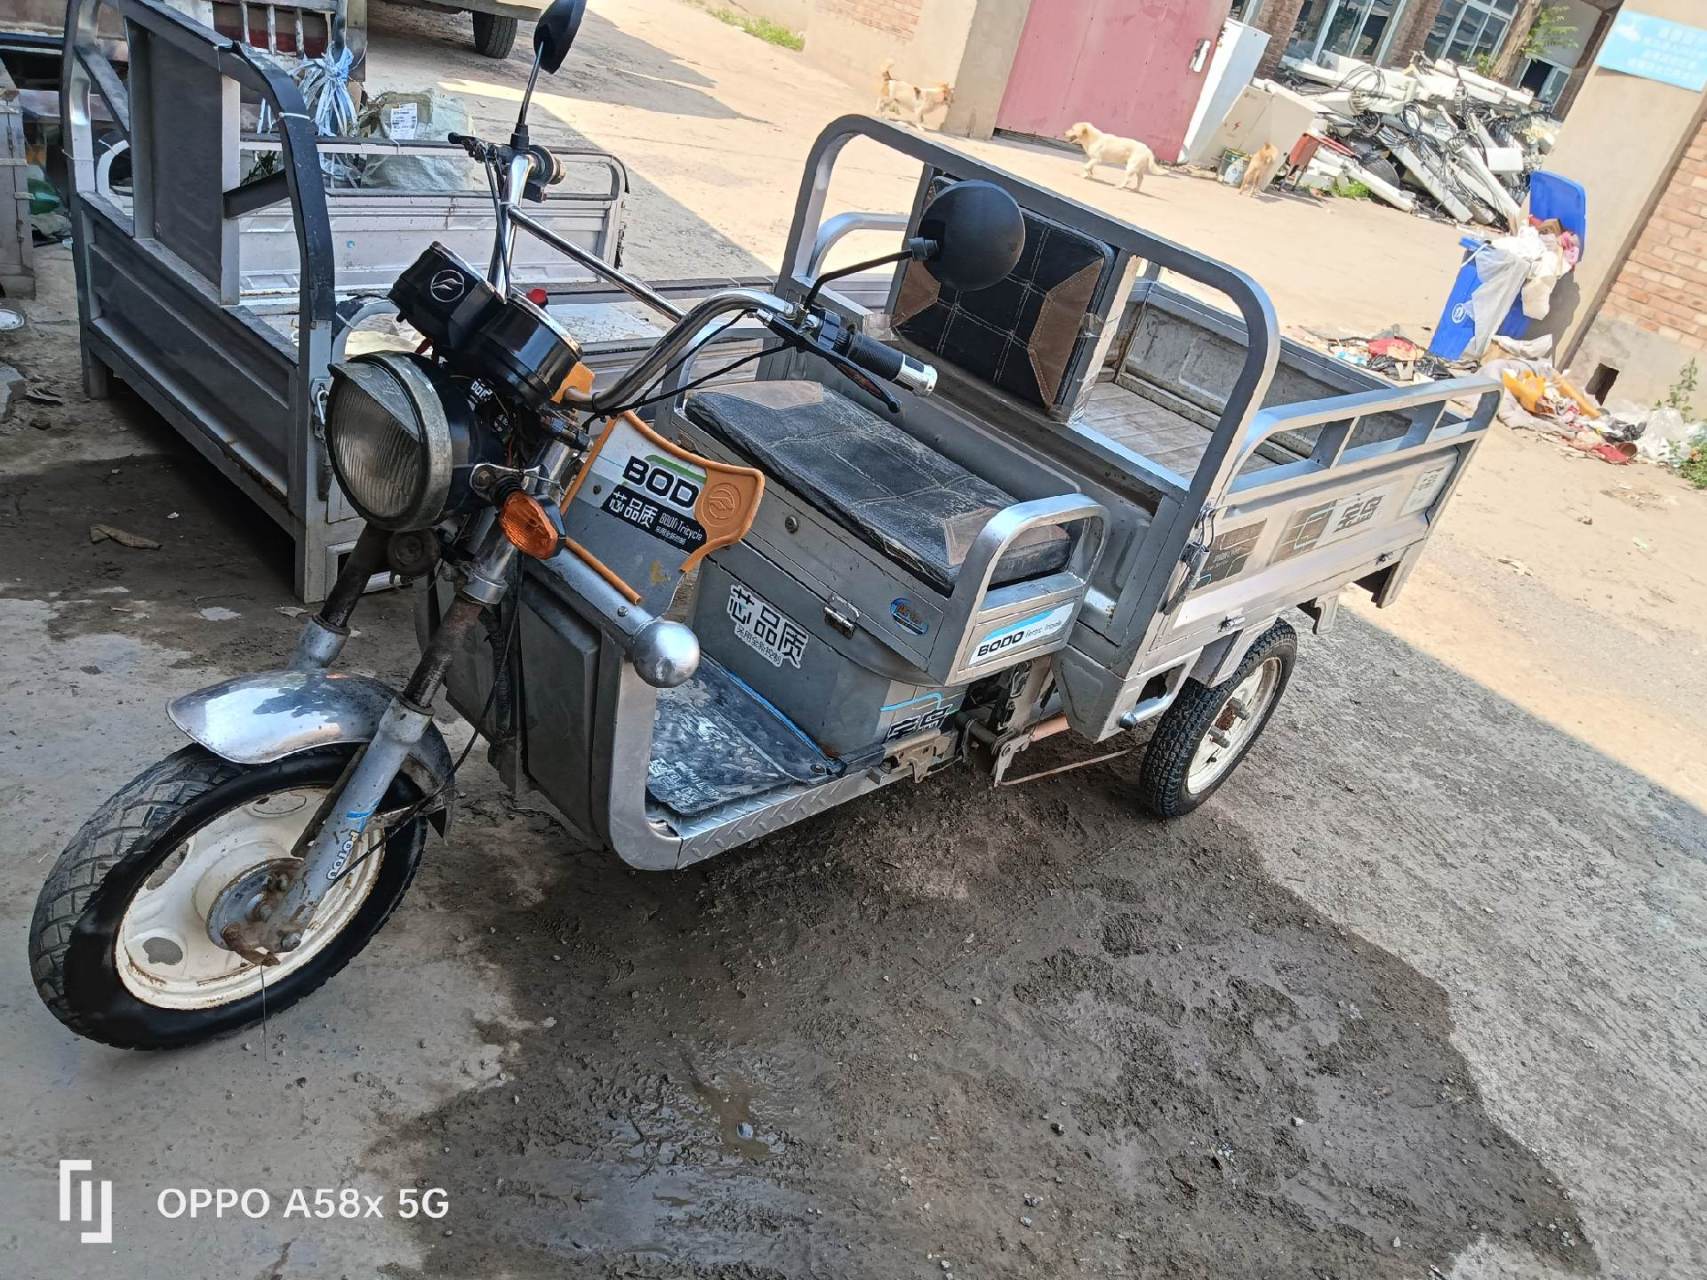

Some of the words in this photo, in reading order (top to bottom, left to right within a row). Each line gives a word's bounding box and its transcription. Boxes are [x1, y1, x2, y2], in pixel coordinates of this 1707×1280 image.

[609, 491, 658, 529] 芯品质
[728, 586, 807, 666] 芯品质
[977, 631, 1025, 657] BODO
